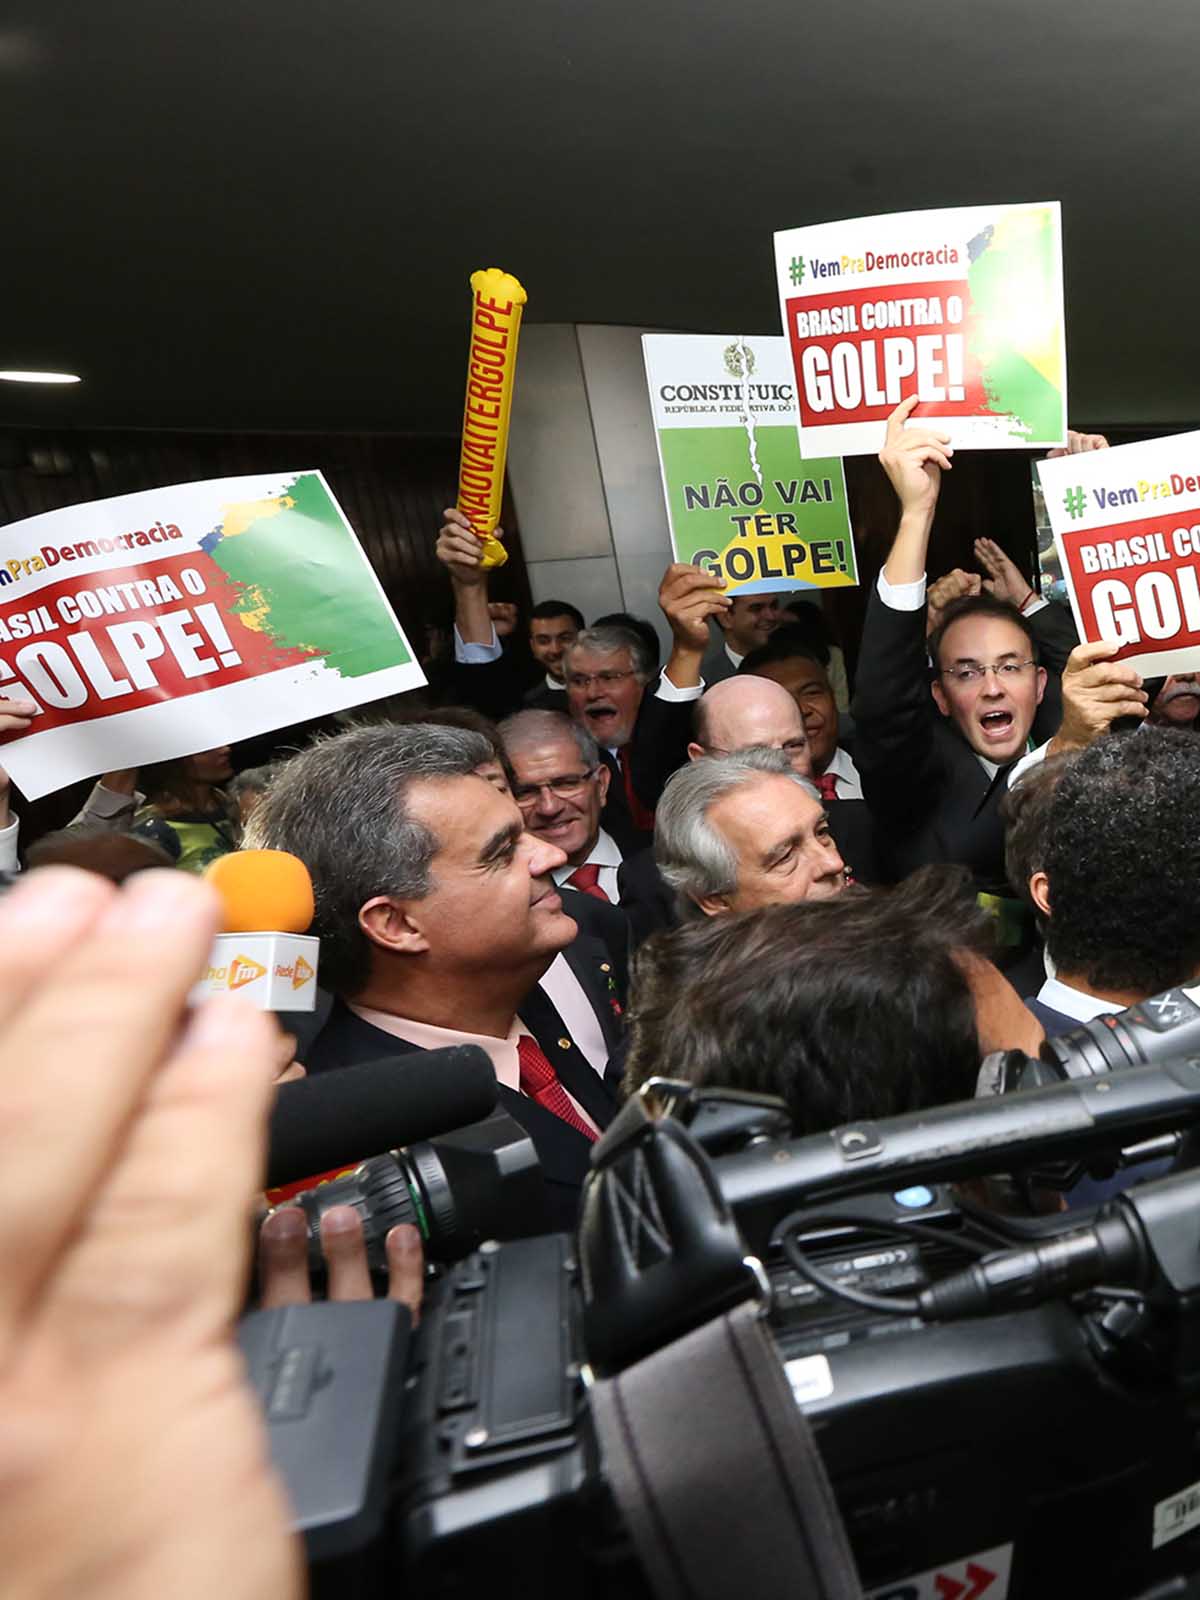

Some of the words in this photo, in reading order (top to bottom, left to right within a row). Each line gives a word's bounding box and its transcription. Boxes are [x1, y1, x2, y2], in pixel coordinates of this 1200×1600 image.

[797, 304, 859, 339] BRASIL
[861, 297, 943, 332] CONTRA
[946, 295, 963, 323] O
[802, 333, 965, 413] GOLPE!
[684, 478, 764, 511] NÃO
[774, 478, 833, 505] VAI
[731, 512, 799, 537] TER
[692, 540, 849, 581] GOLPE!
[1080, 533, 1171, 575] BRASIL
[56, 574, 184, 626] CONTRA
[180, 568, 207, 596] O
